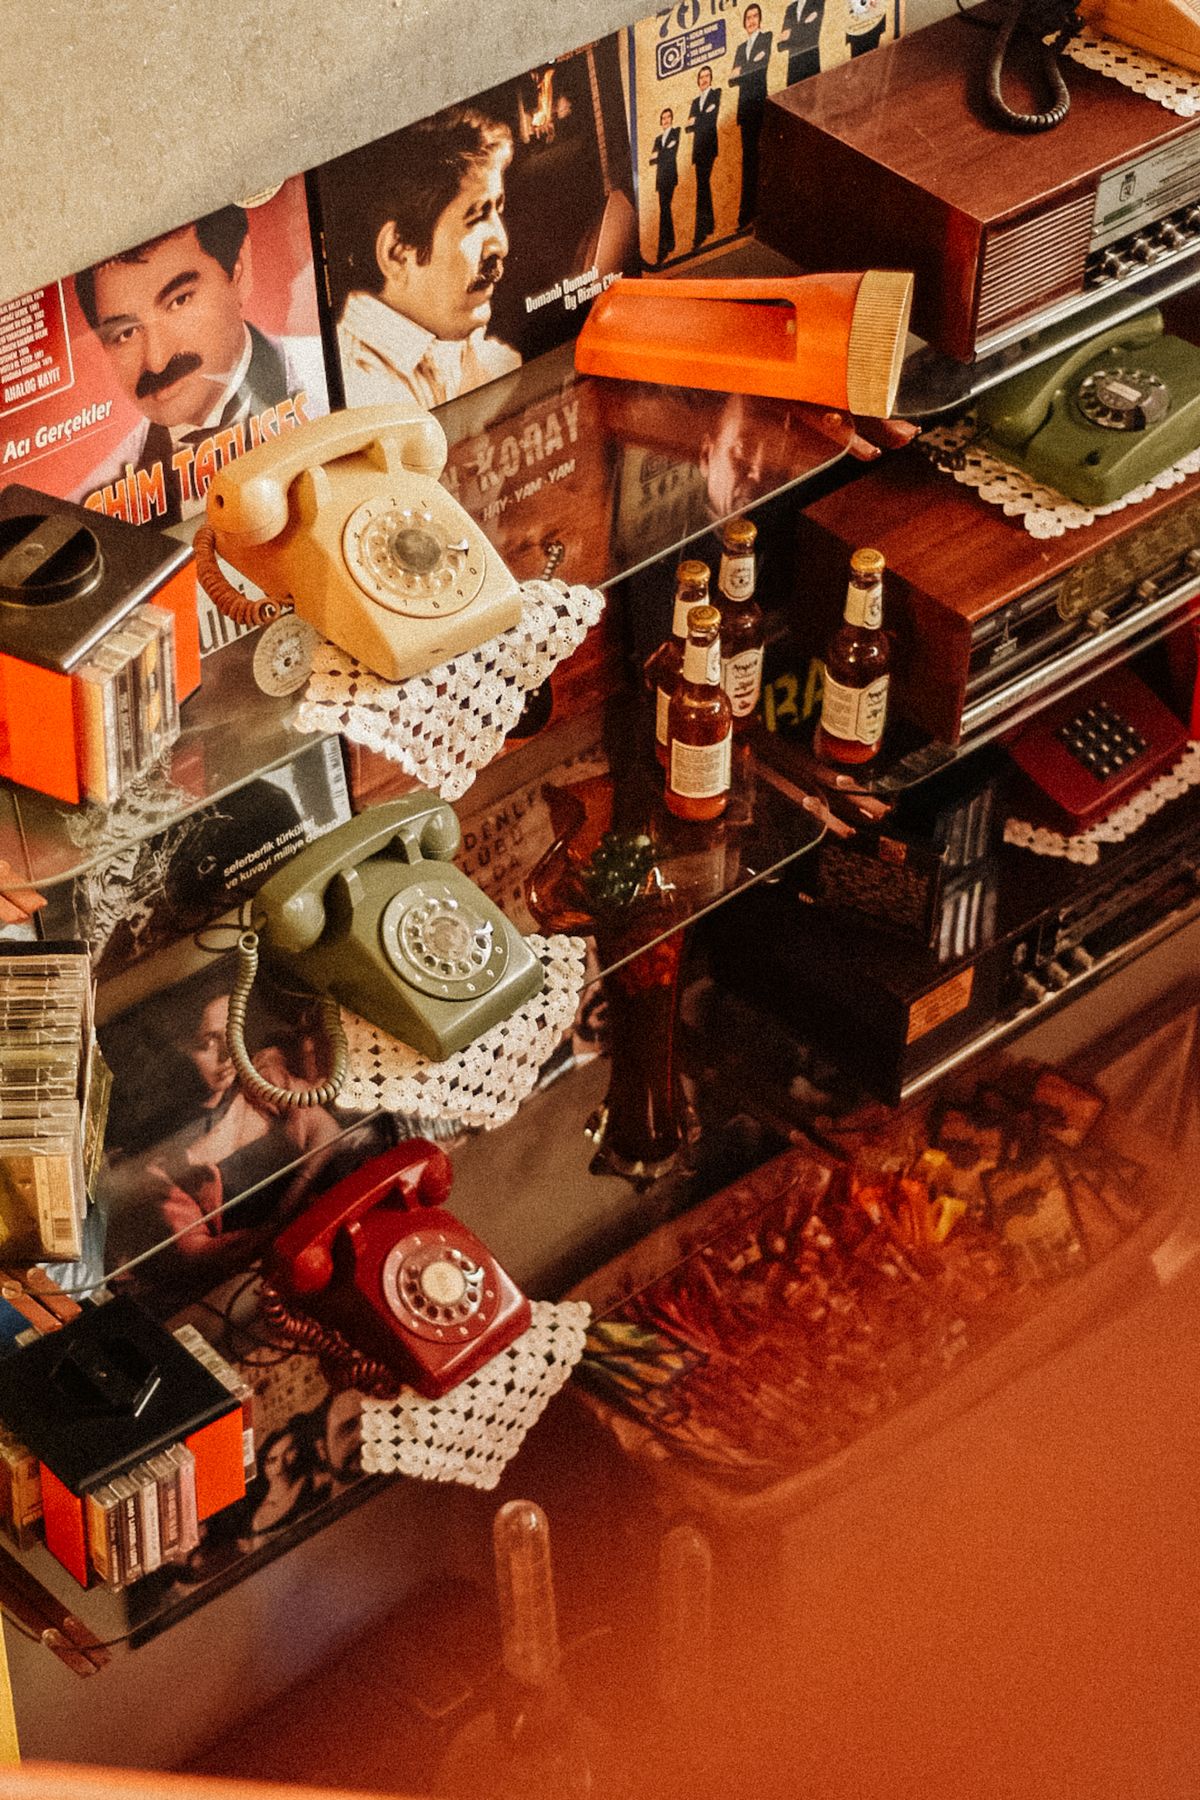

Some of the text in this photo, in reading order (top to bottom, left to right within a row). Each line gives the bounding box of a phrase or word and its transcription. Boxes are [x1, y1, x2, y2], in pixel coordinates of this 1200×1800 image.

[4, 377, 37, 403] ANALOG
[36, 366, 61, 389] KAYIT
[3, 400, 113, 464] Acı Gerçekler
[223, 840, 275, 878] seferberlik
[224, 877, 238, 890] ve
